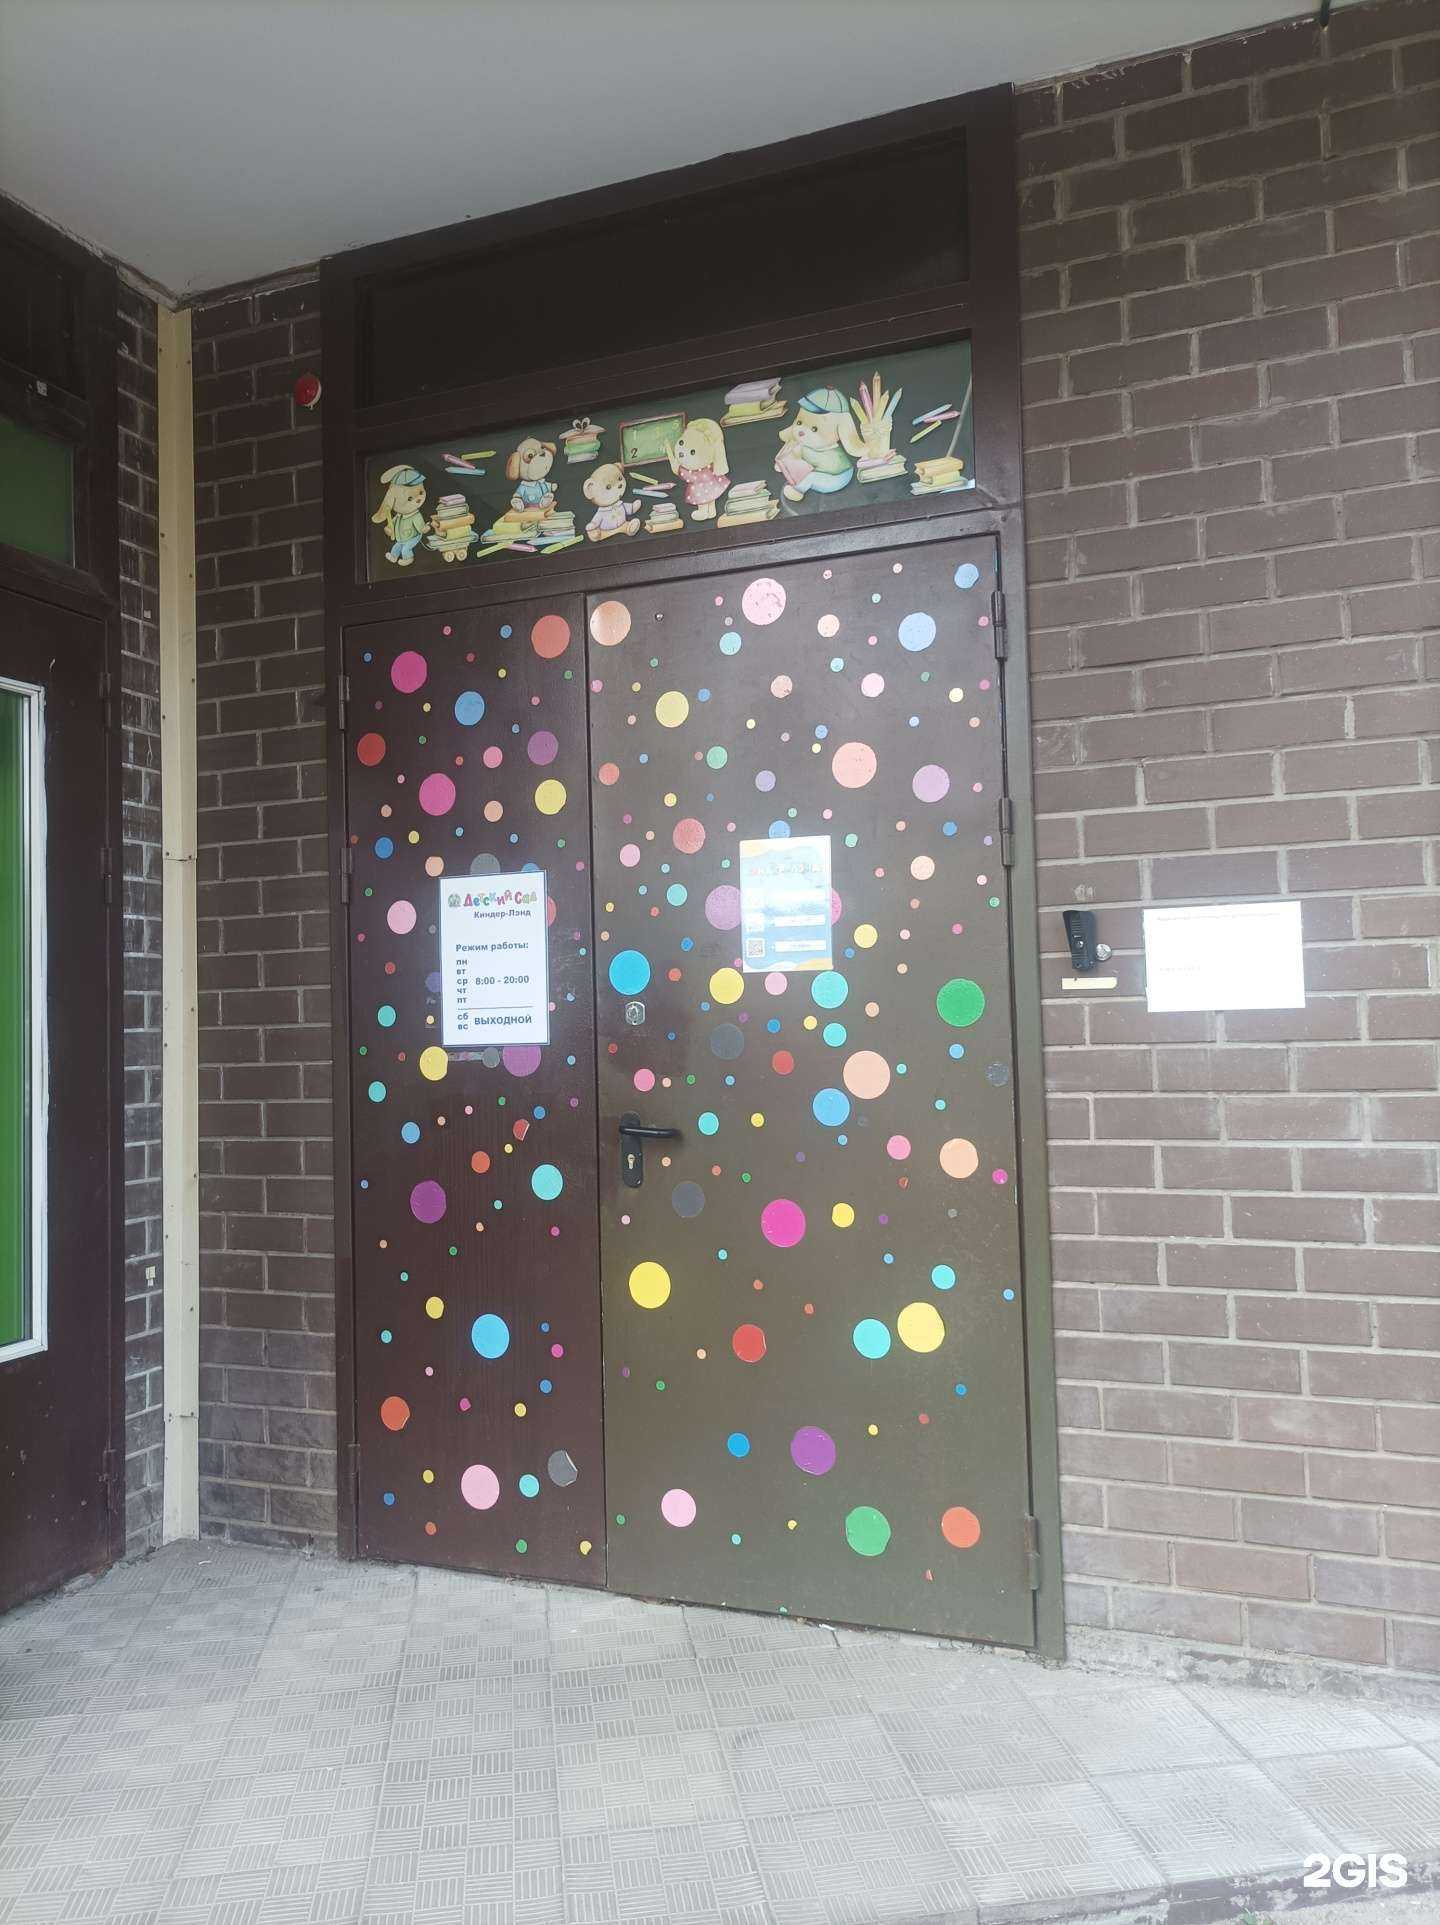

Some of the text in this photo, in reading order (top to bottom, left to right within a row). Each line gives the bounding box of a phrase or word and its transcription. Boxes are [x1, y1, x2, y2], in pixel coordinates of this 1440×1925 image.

[463, 889, 512, 907] Детский
[474, 909, 531, 919] Киндер-Лэнд
[456, 942, 529, 952] Режим работы:
[457, 978, 468, 986] ср
[475, 976, 495, 985] 8:00
[503, 975, 530, 984] 20:00
[457, 996, 467, 1004] пт
[457, 1012, 469, 1021] сб
[474, 1015, 532, 1026] ВЫХОДНОЙ
